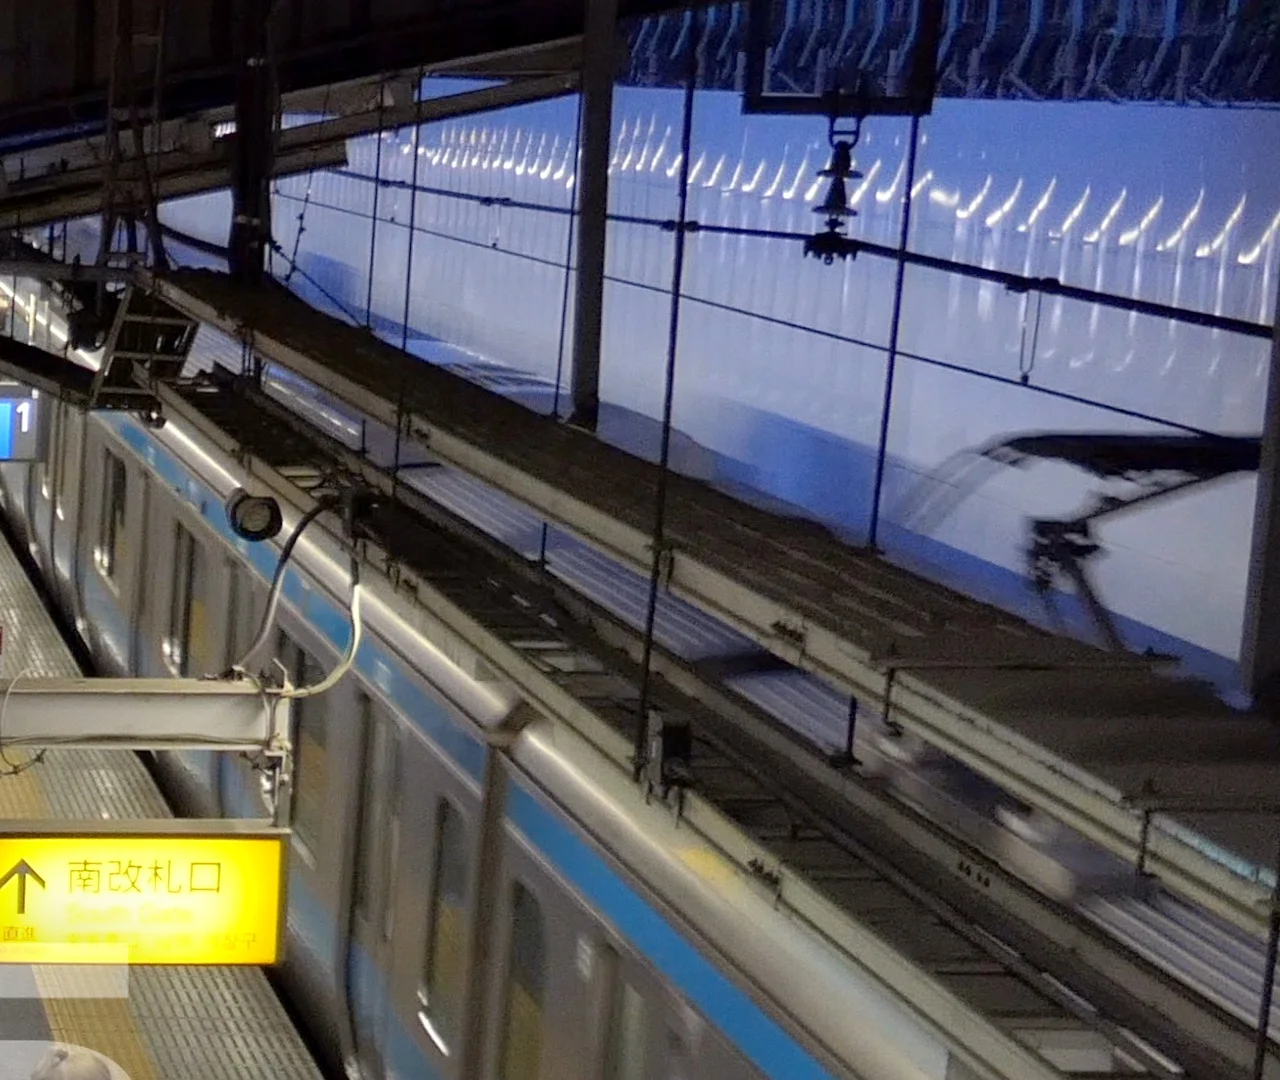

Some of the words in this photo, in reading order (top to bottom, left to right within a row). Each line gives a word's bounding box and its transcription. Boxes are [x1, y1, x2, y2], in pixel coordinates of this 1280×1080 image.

[16, 402, 30, 433] 1
[67, 859, 221, 894] 南改札口
